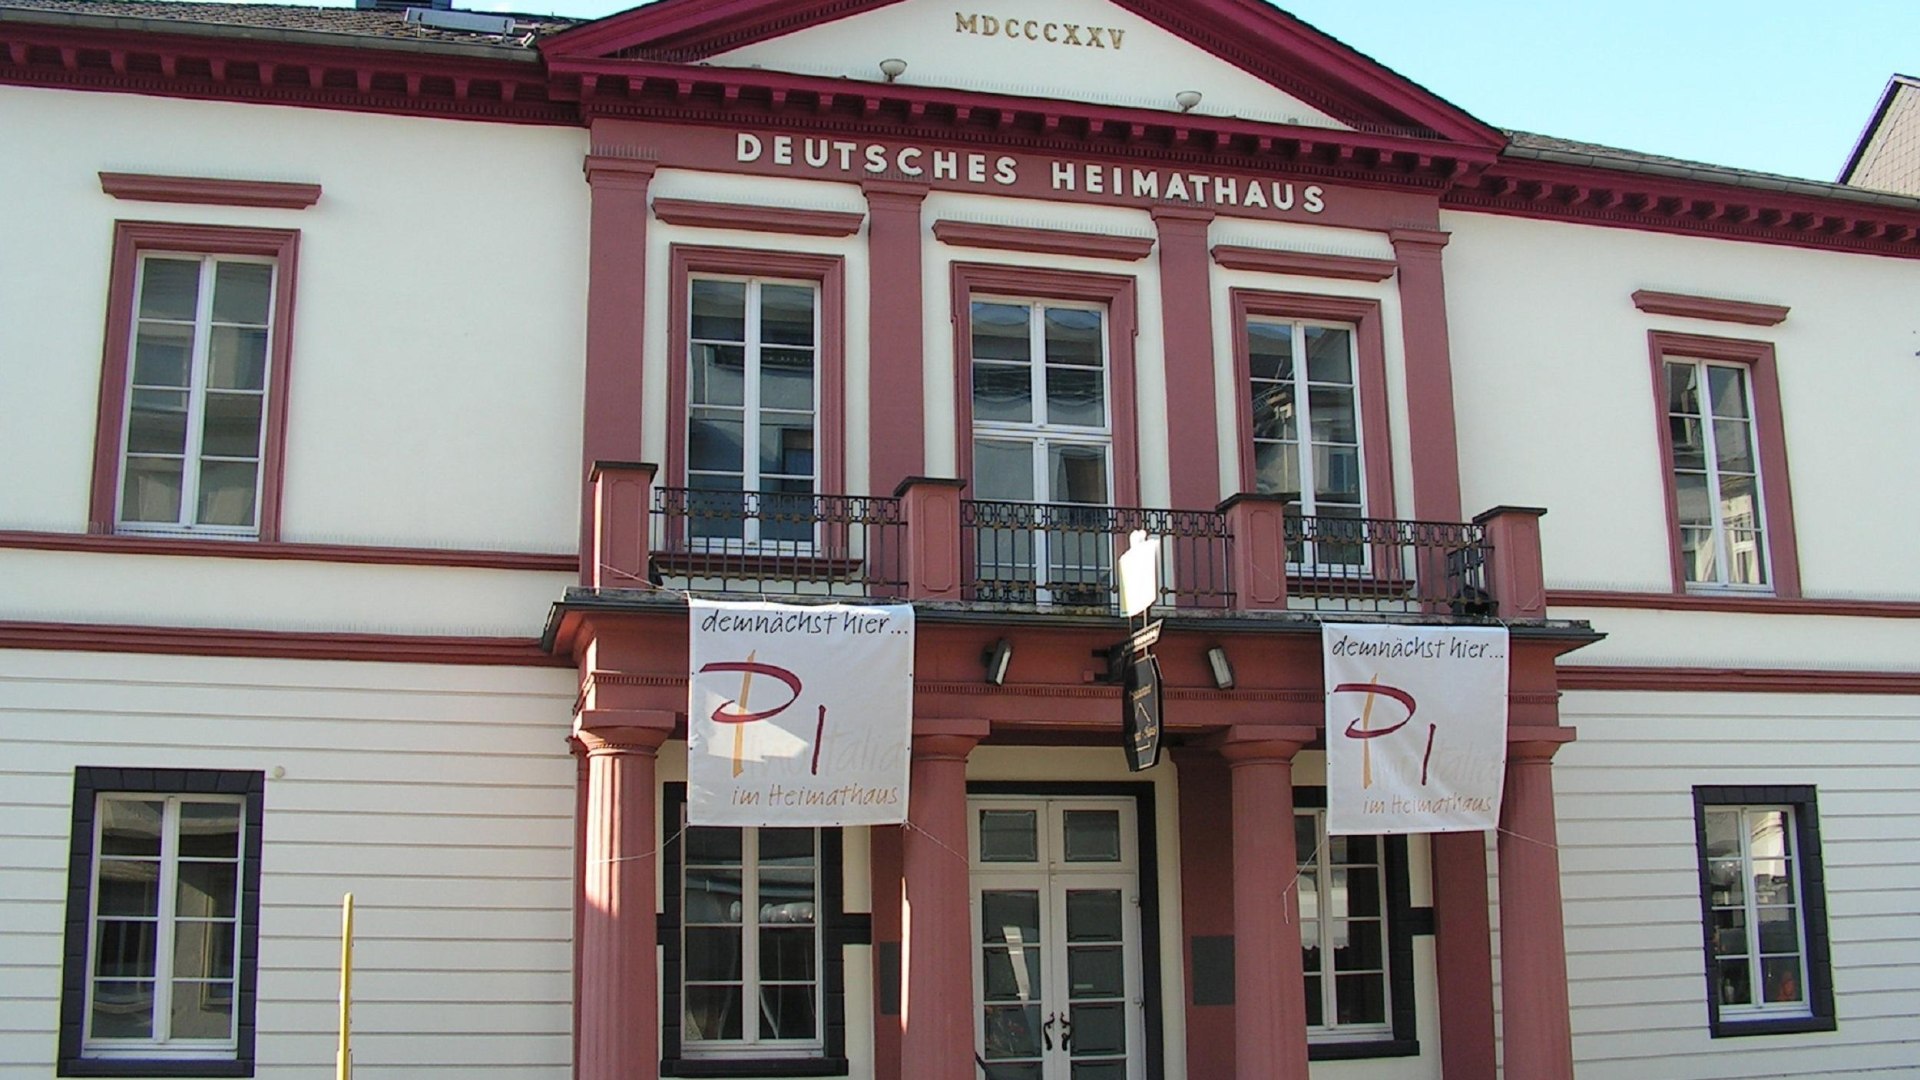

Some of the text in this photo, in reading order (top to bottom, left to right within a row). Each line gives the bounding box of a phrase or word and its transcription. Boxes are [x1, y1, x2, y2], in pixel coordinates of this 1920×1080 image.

[956, 11, 1126, 50] MDCCCXXV
[736, 132, 1326, 214] DEUTSCHES HEIMATHAUS
[701, 608, 837, 635] demnächst
[1332, 634, 1446, 660] demnächst
[731, 782, 899, 806] im Heimathaus
[1362, 792, 1492, 815] im Heimathaus
